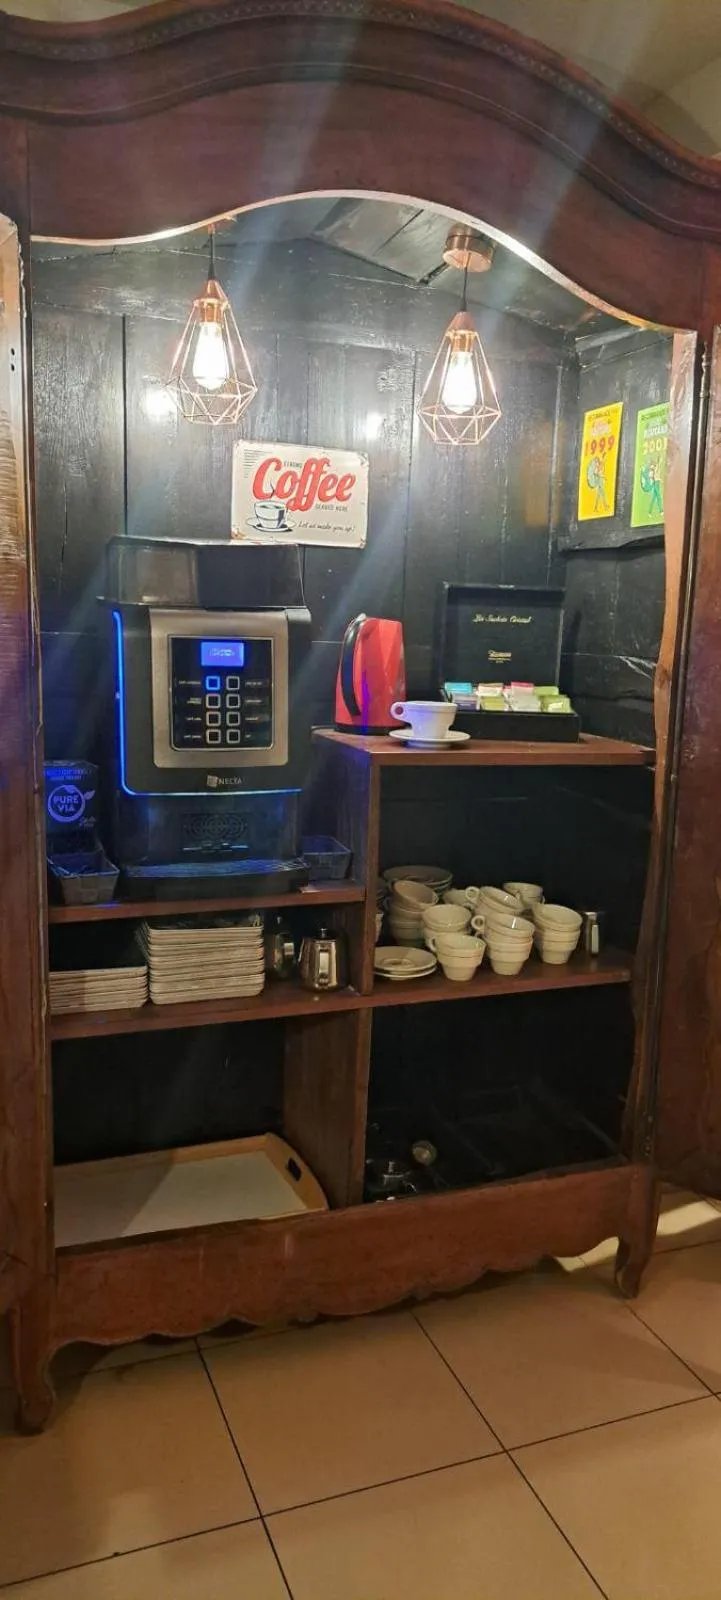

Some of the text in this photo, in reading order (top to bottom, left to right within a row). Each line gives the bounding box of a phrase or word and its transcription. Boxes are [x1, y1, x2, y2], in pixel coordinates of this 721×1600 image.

[584, 435, 614, 456] 1999
[253, 457, 356, 512] Coffee
[298, 520, 308, 528] Let
[53, 795, 79, 804] PURE
[58, 804, 76, 813] VIA
